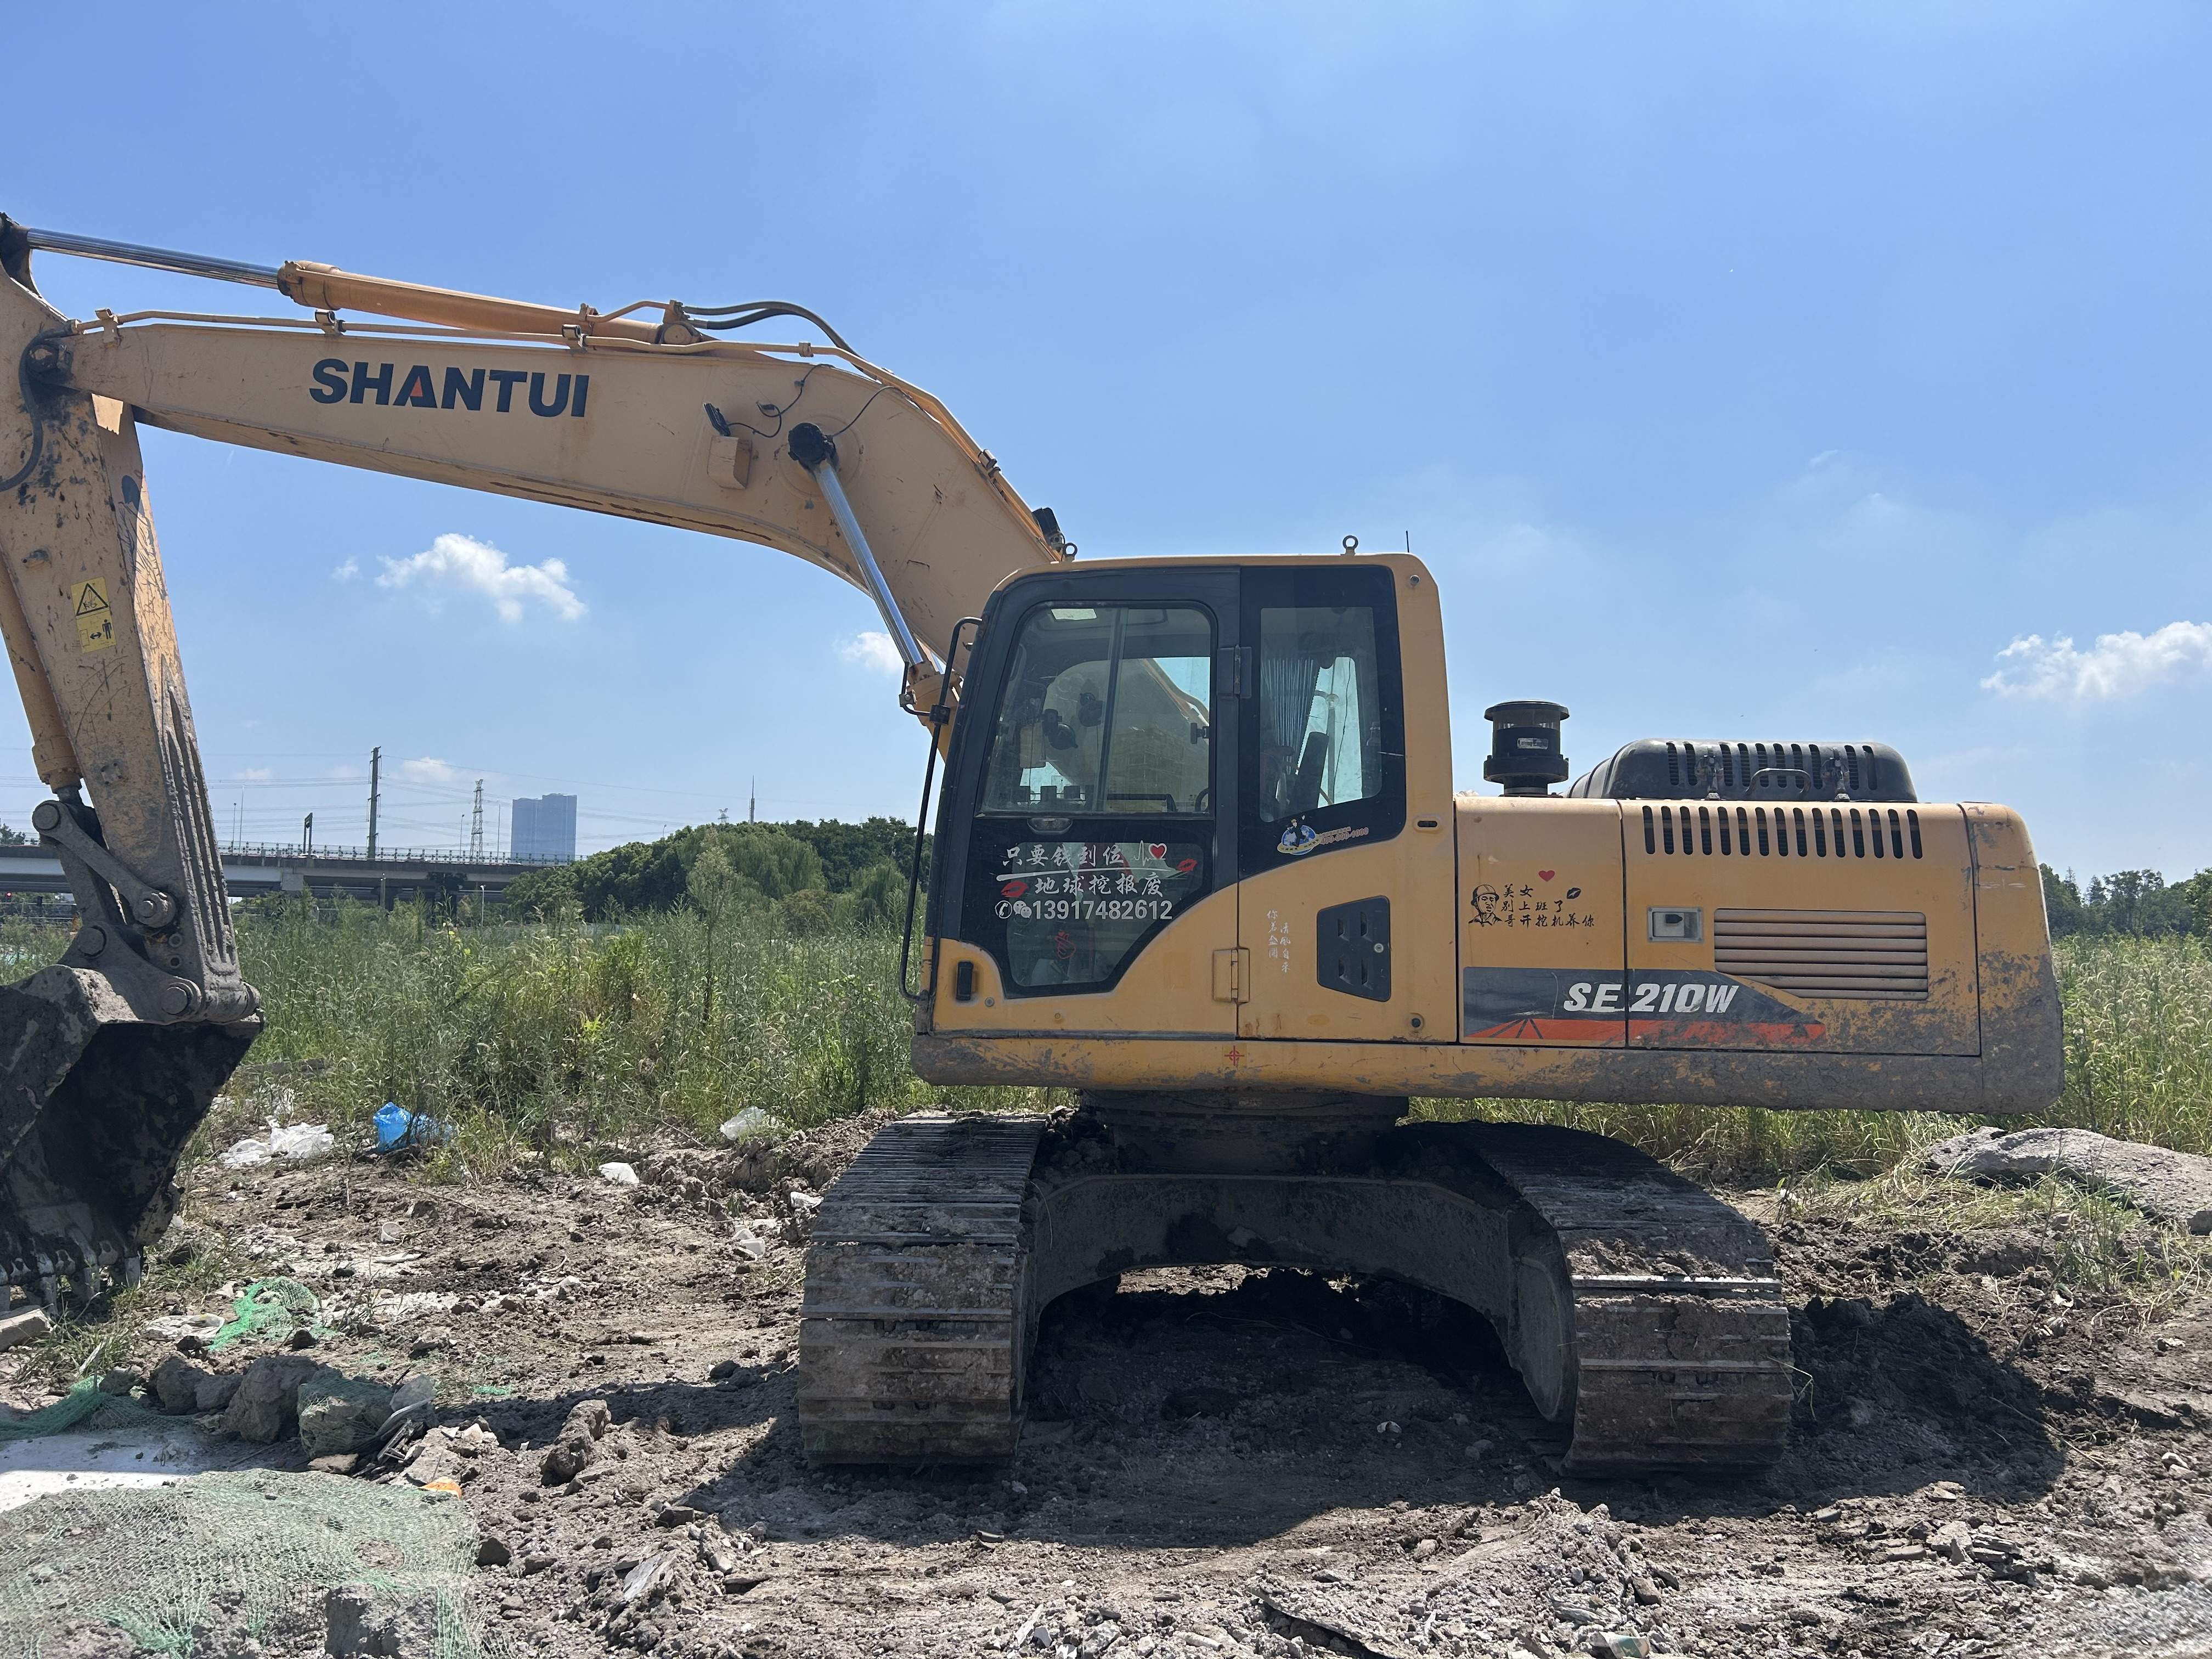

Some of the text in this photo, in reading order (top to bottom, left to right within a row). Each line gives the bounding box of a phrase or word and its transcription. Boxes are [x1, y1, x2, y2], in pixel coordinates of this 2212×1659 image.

[309, 358, 589, 417] SHANTUI
[1002, 844, 1124, 867] 只要钱到位
[1035, 872, 1163, 898] 地球挖报废
[1503, 883, 1533, 898] 美女
[1032, 900, 1173, 920] 13917482612
[1501, 899, 1563, 912] 别上班了
[1505, 913, 1594, 929] 哥开挖机养你
[1564, 983, 1739, 1013] SE 210W
